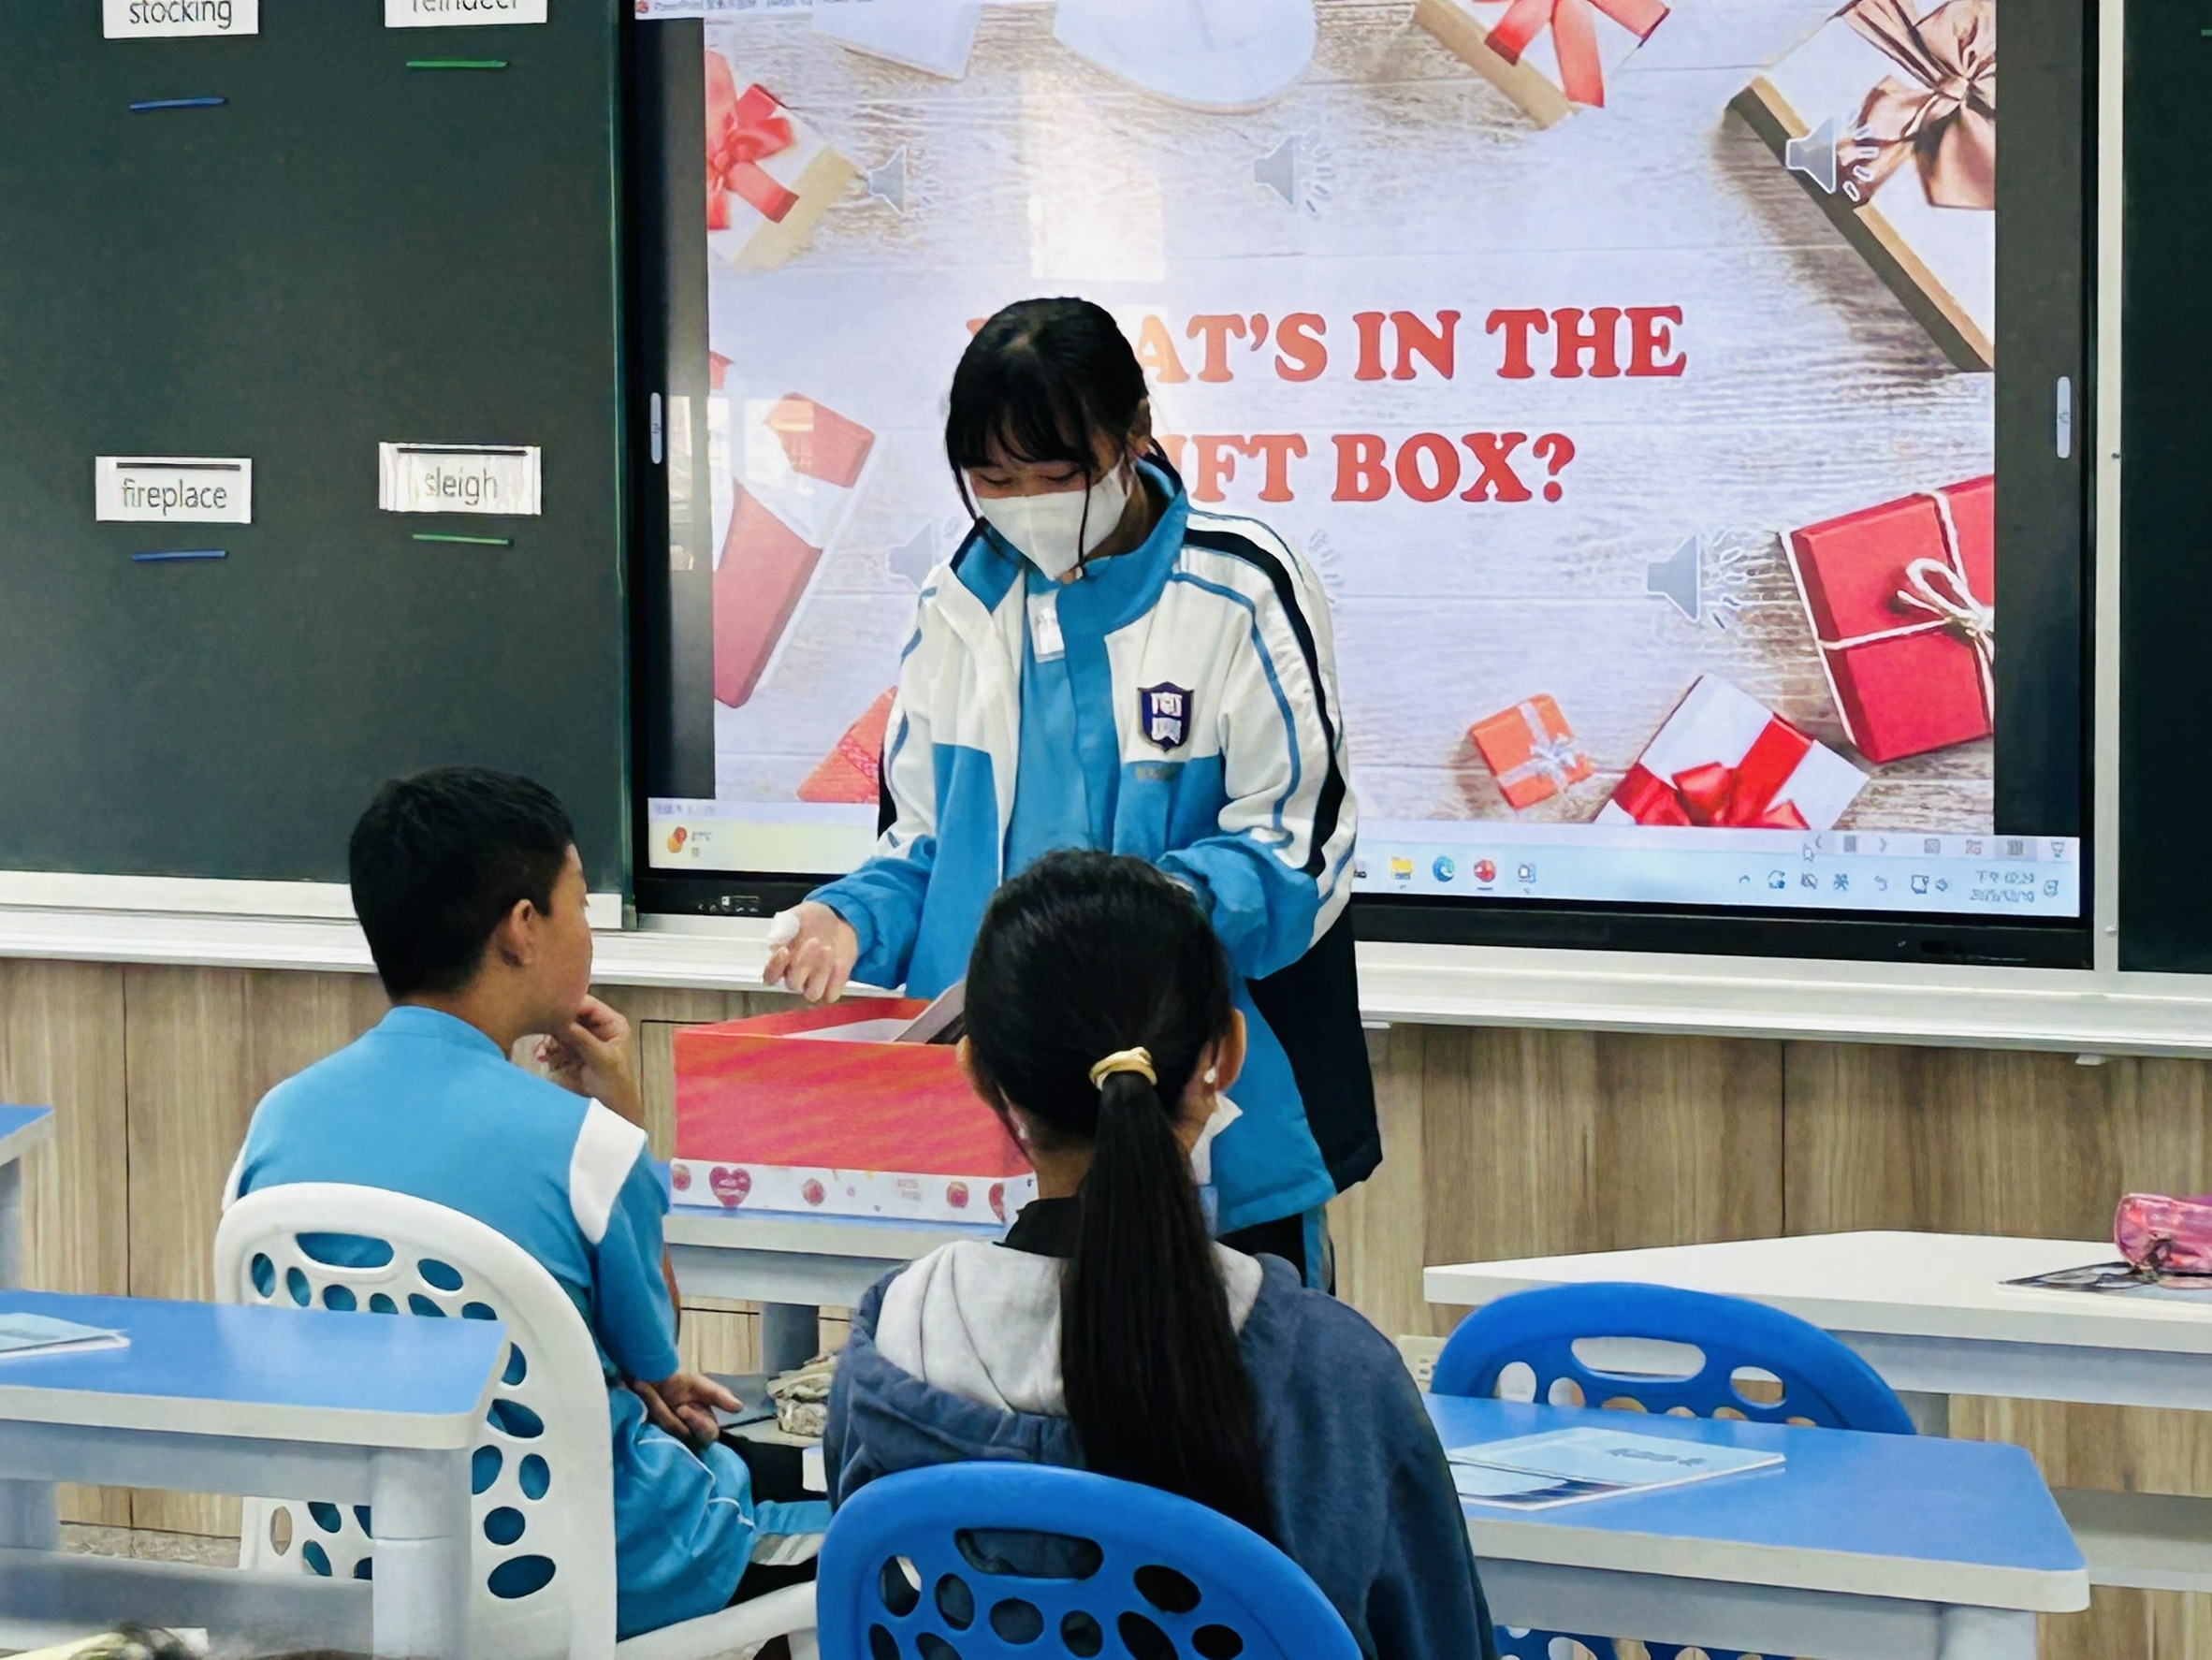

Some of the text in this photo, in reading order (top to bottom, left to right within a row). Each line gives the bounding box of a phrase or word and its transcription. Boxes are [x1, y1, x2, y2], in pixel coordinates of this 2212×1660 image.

[129, 0, 232, 30] stocking
[1353, 310, 1462, 381] IN
[1486, 306, 1687, 379] THE
[425, 466, 498, 506] sleigh
[1157, 431, 1576, 503] FT BOX?
[122, 477, 227, 516] fireplace
